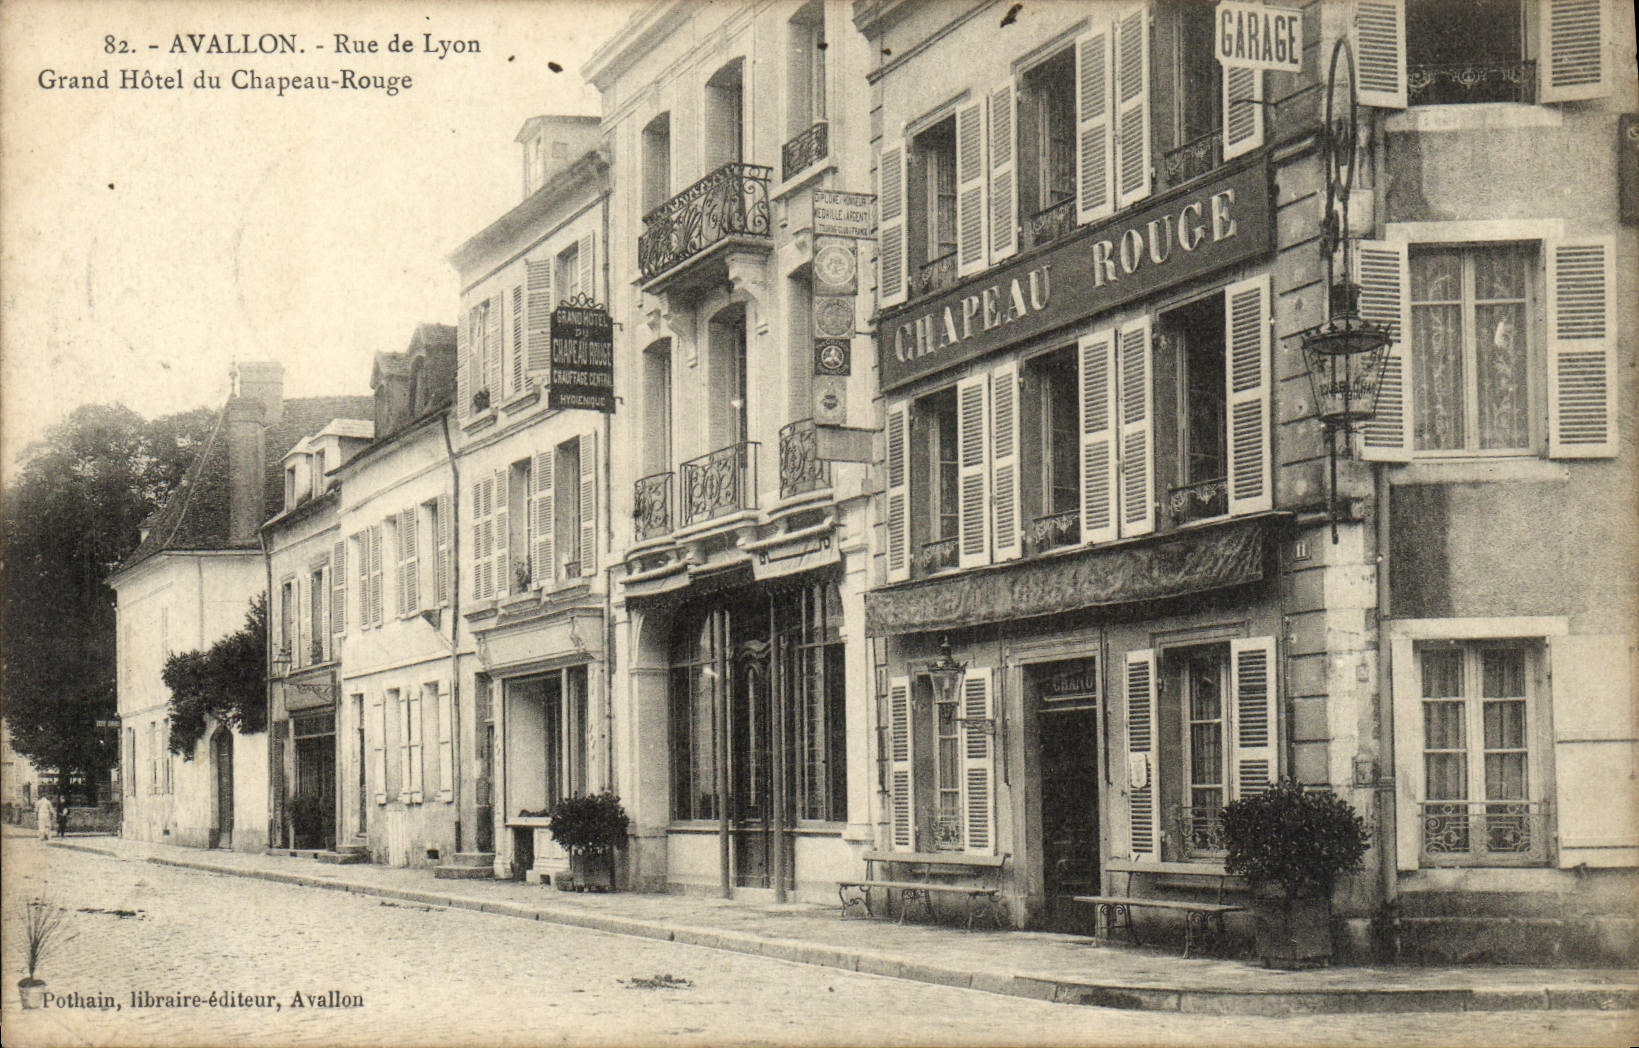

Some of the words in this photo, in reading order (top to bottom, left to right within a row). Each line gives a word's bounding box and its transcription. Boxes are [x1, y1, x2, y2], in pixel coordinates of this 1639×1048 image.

[1221, 9, 1299, 64] GARAGE
[894, 264, 1052, 363] CHAPEAU
[1092, 188, 1238, 289] ROUGE
[553, 338, 589, 365] CHAPEAU
[590, 341, 612, 367] ROUGE
[575, 328, 589, 338] DU
